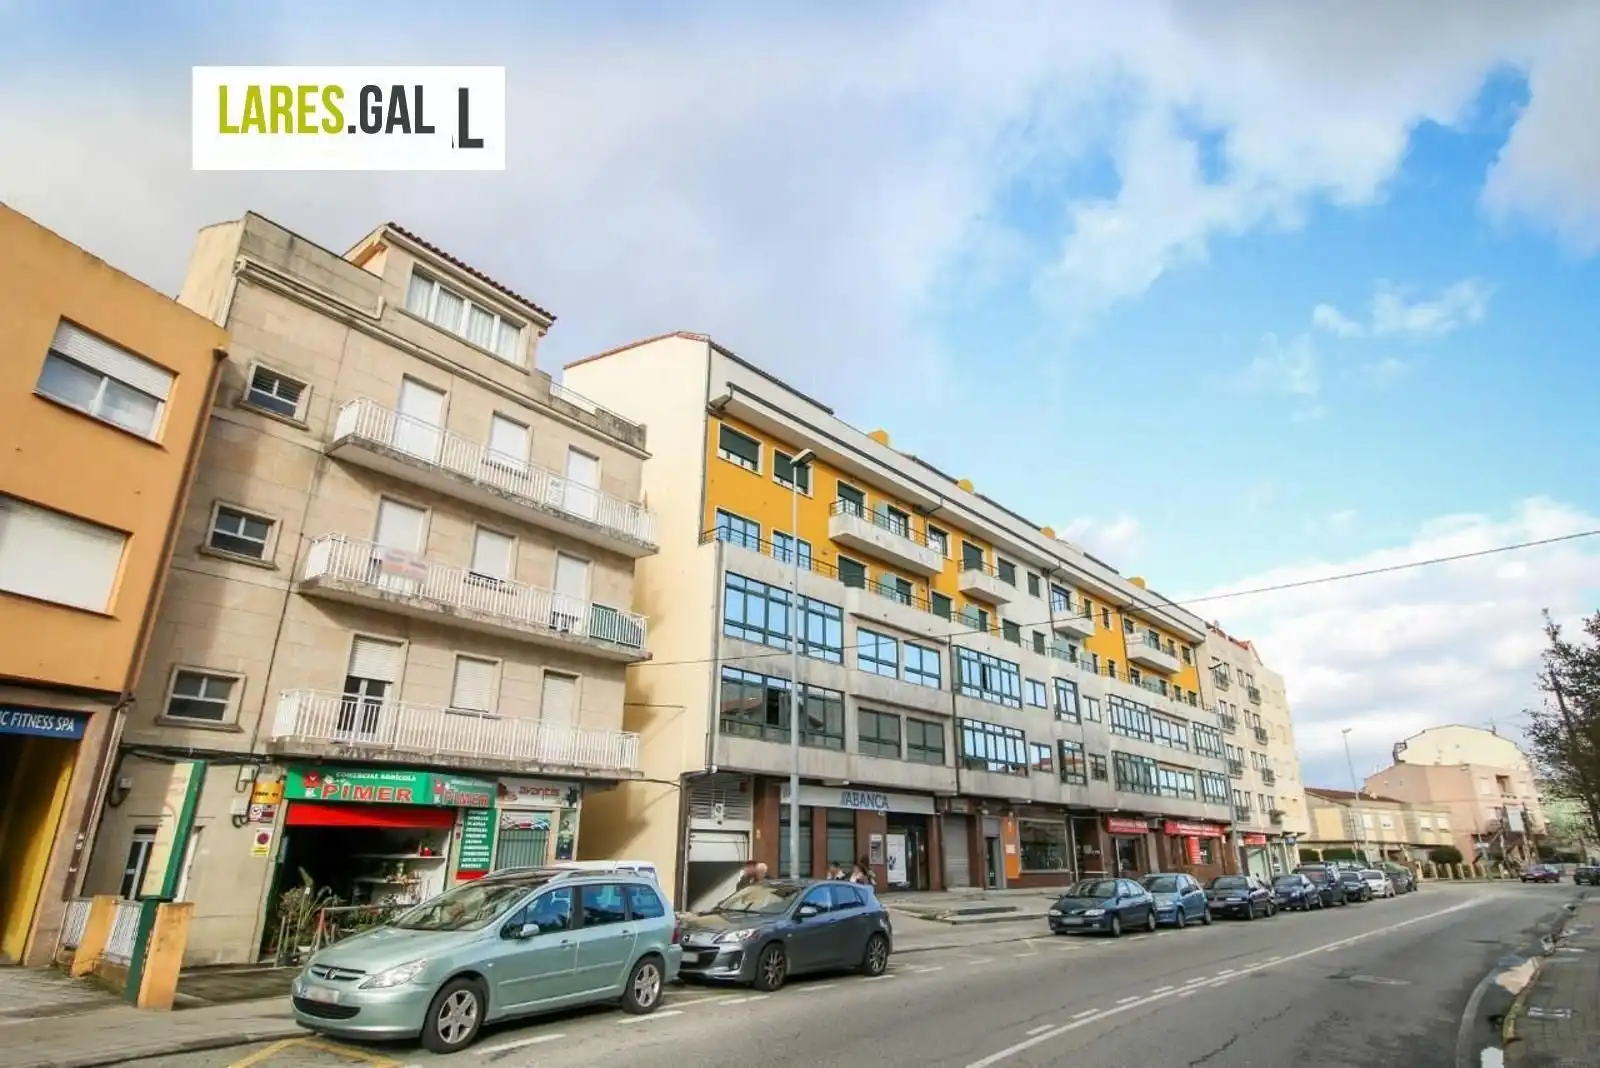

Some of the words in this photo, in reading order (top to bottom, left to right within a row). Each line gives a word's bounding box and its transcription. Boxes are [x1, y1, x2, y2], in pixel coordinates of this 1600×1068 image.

[10, 712, 55, 730] FITNESS
[55, 716, 75, 732] SPA
[321, 783, 413, 803] PIMER
[443, 789, 490, 808] PIMER
[842, 791, 889, 809] ABANCA
